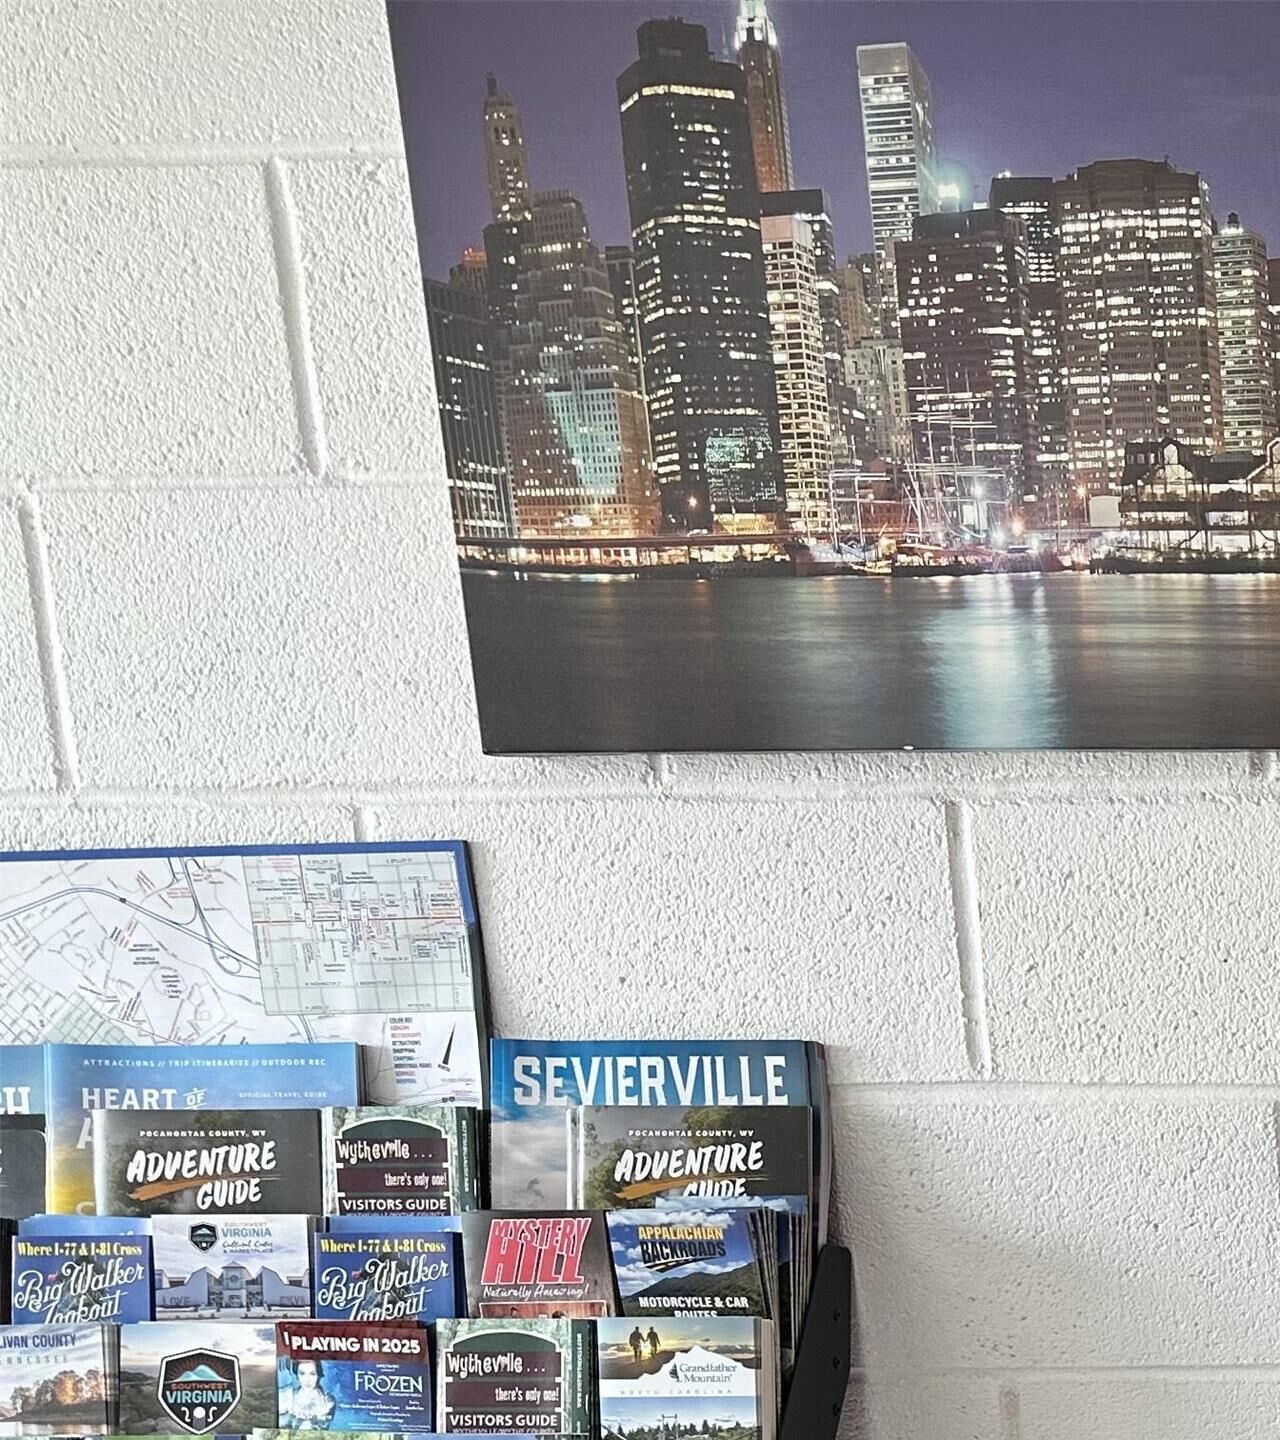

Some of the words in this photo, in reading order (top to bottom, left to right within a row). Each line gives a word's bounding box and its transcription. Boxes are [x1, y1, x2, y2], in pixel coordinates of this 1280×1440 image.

[84, 1059, 155, 1067] ATTRACTIONS
[262, 1058, 306, 1067] OUTDOOR
[513, 1055, 789, 1106] SEVIERVILLE
[81, 1087, 178, 1110] HEART
[185, 1092, 205, 1107] OF
[208, 1130, 249, 1138] COUNTY,
[251, 1129, 266, 1137] WV
[628, 1129, 692, 1137] POCAHONTAS
[695, 1129, 736, 1138] COUNTY,
[739, 1129, 755, 1137] WV
[126, 1141, 278, 1183] ADVENTURE
[614, 1140, 764, 1183] ADVENTURE
[196, 1178, 263, 1210] GUIDE
[342, 1199, 402, 1211] VISITORS
[405, 1199, 447, 1211] GUIDE
[222, 1228, 272, 1238] VIRGINIA
[490, 1218, 593, 1252] MYSTERY
[638, 1225, 724, 1240] APPALACHIAN
[17, 1242, 52, 1257] Where
[320, 1239, 356, 1253] Where
[416, 1240, 446, 1252] Cross
[641, 1241, 727, 1264] BACKROADS
[480, 1235, 585, 1285] HILL
[14, 1270, 63, 1311] Big
[62, 1257, 146, 1296] Walker
[318, 1266, 368, 1309] Big
[365, 1254, 450, 1293] Walker
[483, 1285, 532, 1300] Naturally
[638, 1296, 714, 1308] MOTORCYCLE
[715, 1297, 724, 1307] &
[726, 1297, 749, 1308] CAR
[33, 1334, 76, 1348] COUNTY
[291, 1336, 361, 1352] PLAYING
[363, 1338, 380, 1352] IN
[381, 1339, 421, 1354] 2025
[679, 1363, 737, 1374] Grandfather
[170, 1382, 228, 1390] SOUTHWEST
[354, 1371, 423, 1396] FROZEN
[684, 1374, 731, 1383] Mountain
[165, 1390, 233, 1404] VIRGINIA
[450, 1414, 513, 1426] VISITORS
[515, 1414, 558, 1426] GUIDE
